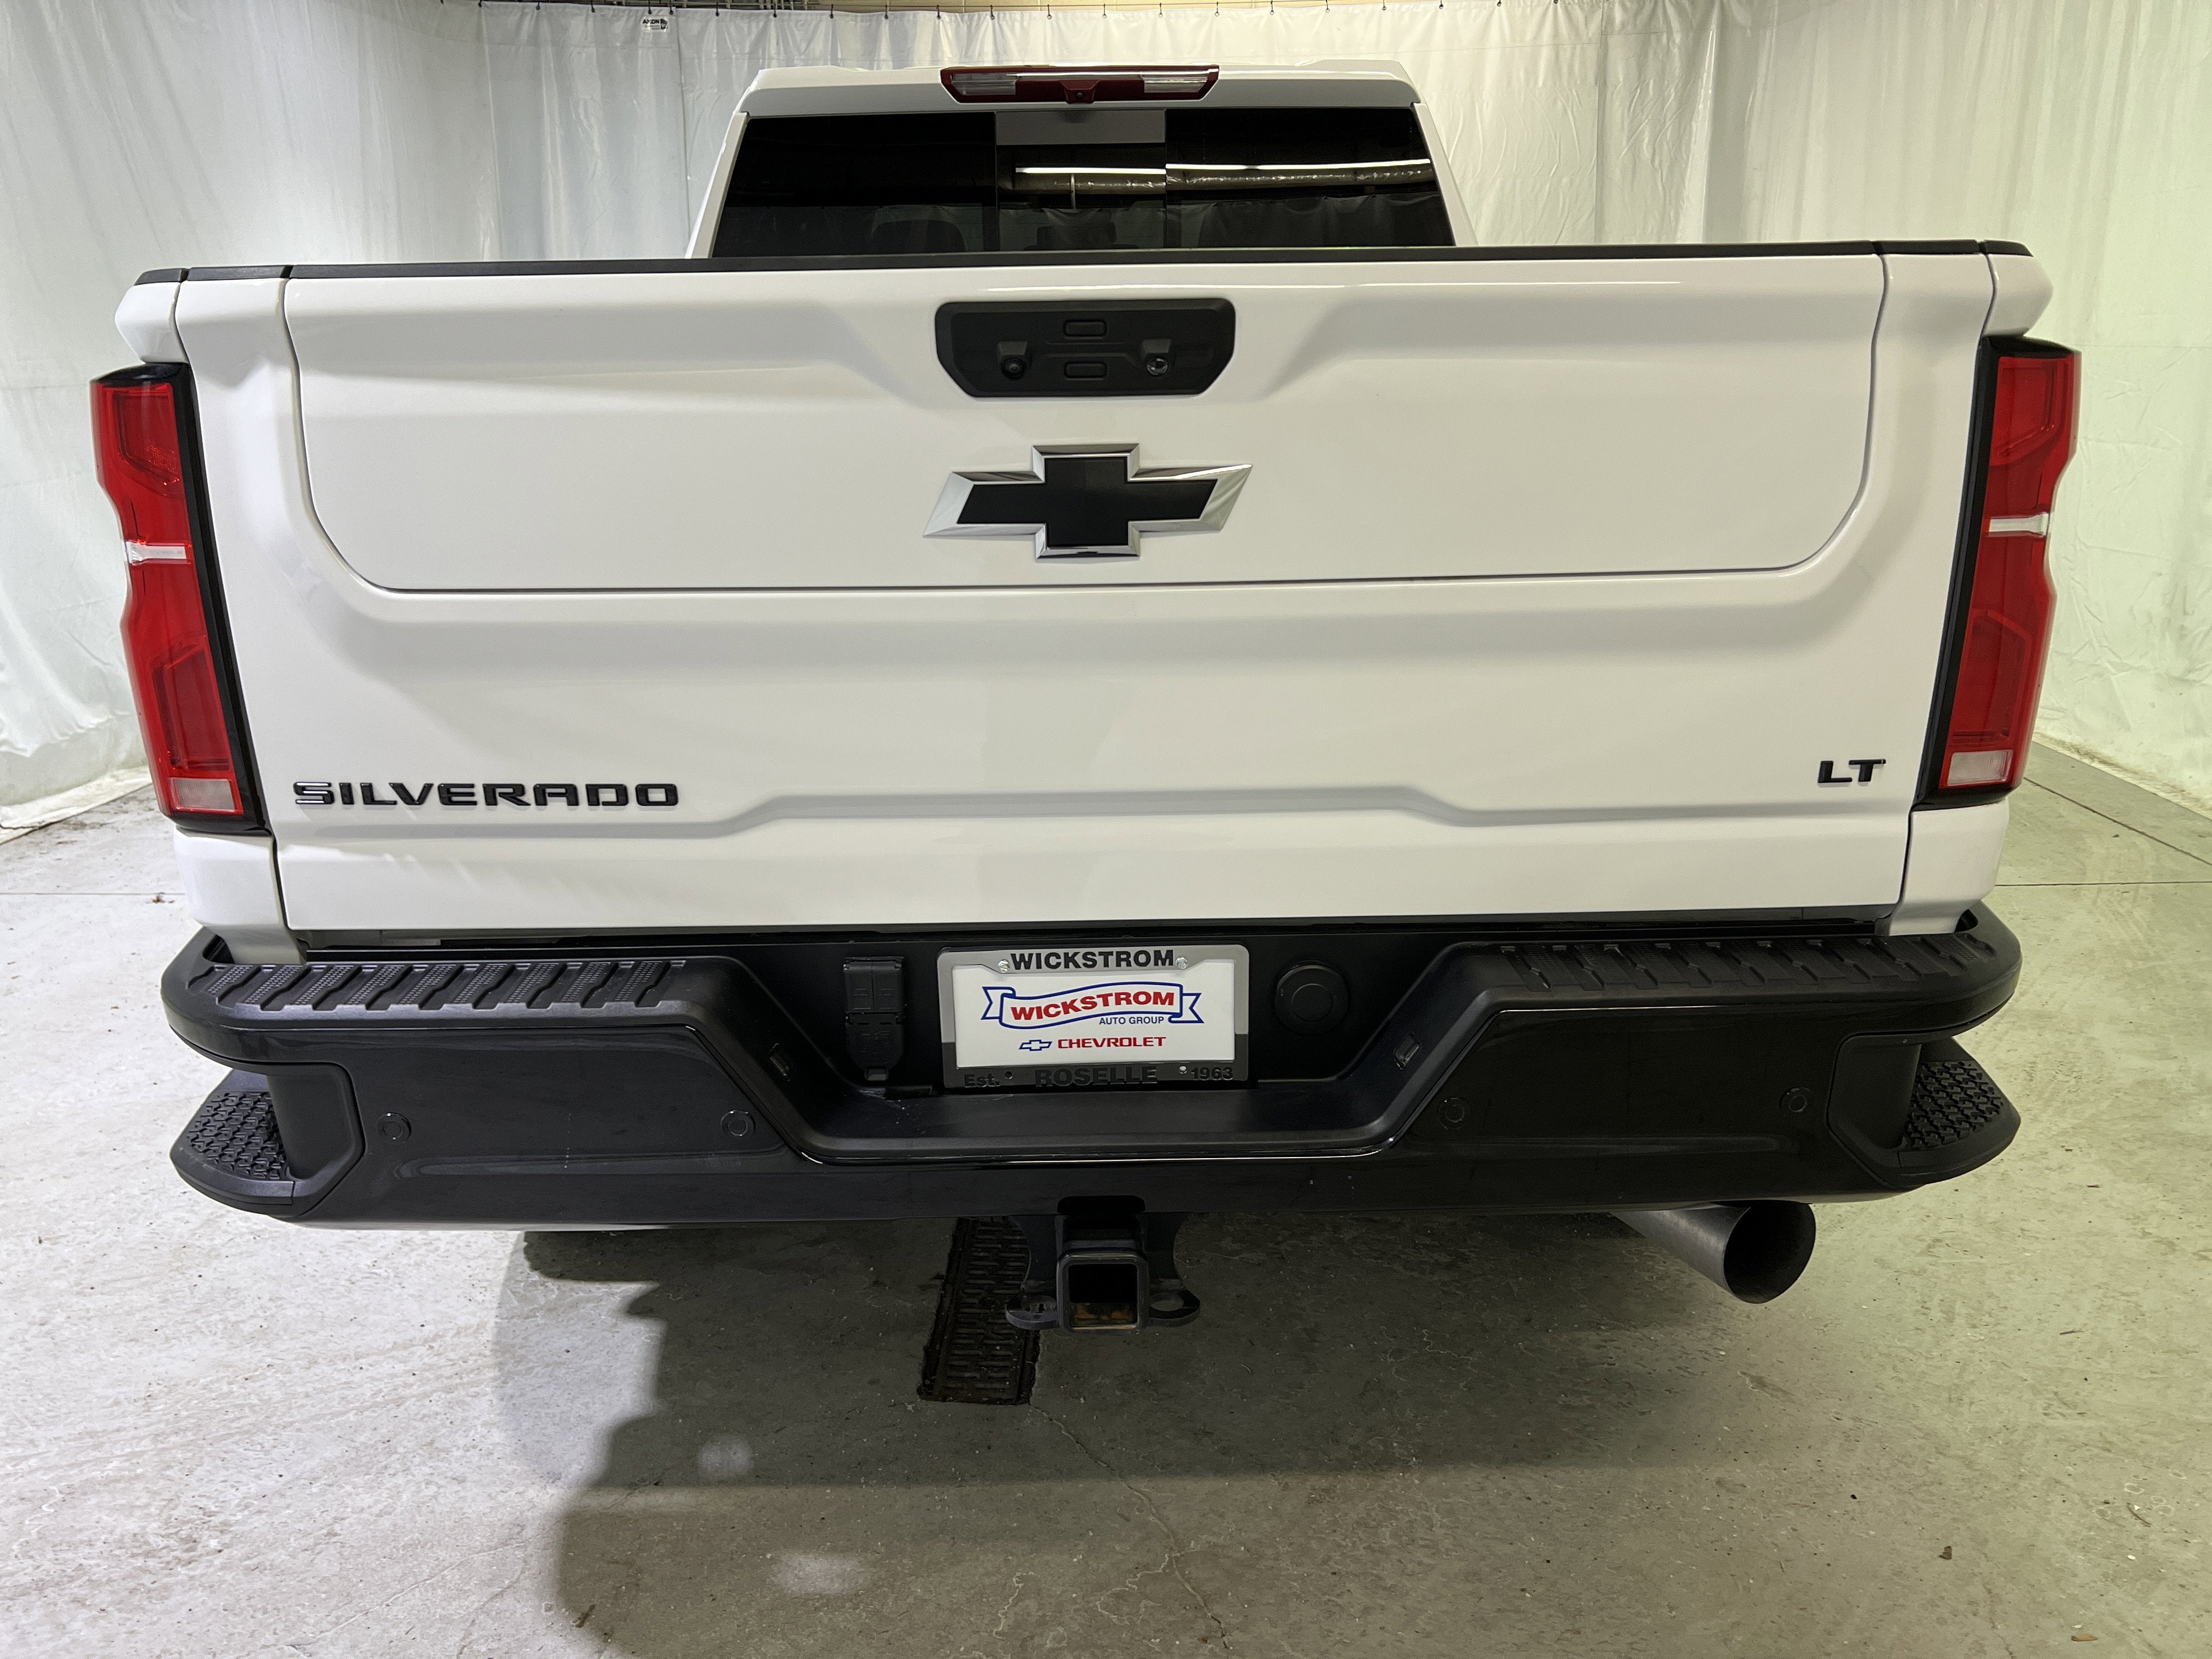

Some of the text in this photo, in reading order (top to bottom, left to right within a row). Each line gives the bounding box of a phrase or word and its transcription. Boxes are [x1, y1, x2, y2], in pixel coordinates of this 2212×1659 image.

[1817, 759, 1886, 783] LT
[293, 781, 679, 806] SILVERADO
[1010, 949, 1175, 970] WICKSTROM
[1011, 991, 1175, 1021] WICKSTROM
[1128, 1016, 1165, 1025] GROUP
[1057, 1036, 1166, 1049] CHEVROLET
[964, 1066, 1233, 1087] Est. ROSELLE 1963
